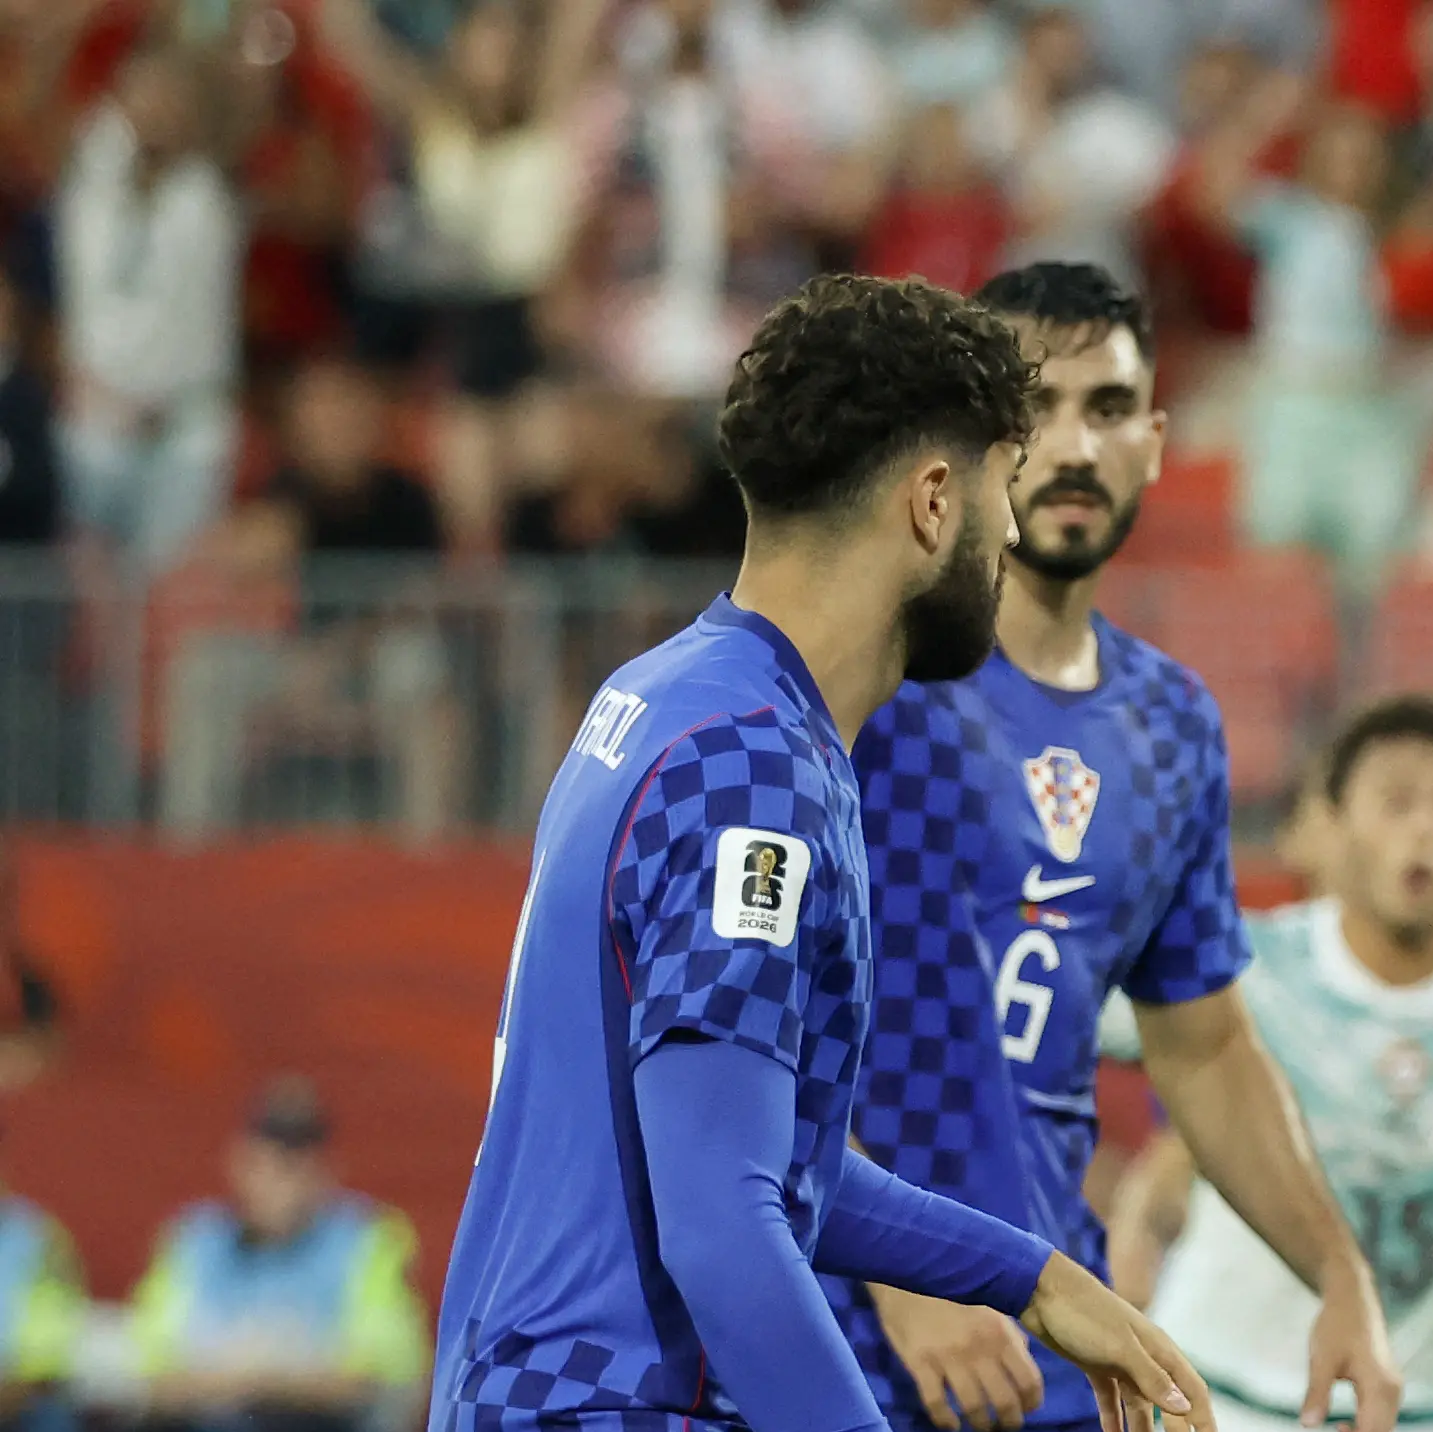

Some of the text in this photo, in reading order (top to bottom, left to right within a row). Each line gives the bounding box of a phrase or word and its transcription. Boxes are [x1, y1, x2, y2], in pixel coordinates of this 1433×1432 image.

[752, 893, 773, 906] FIFA
[739, 911, 767, 919] WORLD
[738, 918, 777, 934] 2026
[993, 929, 1061, 1064] 6
